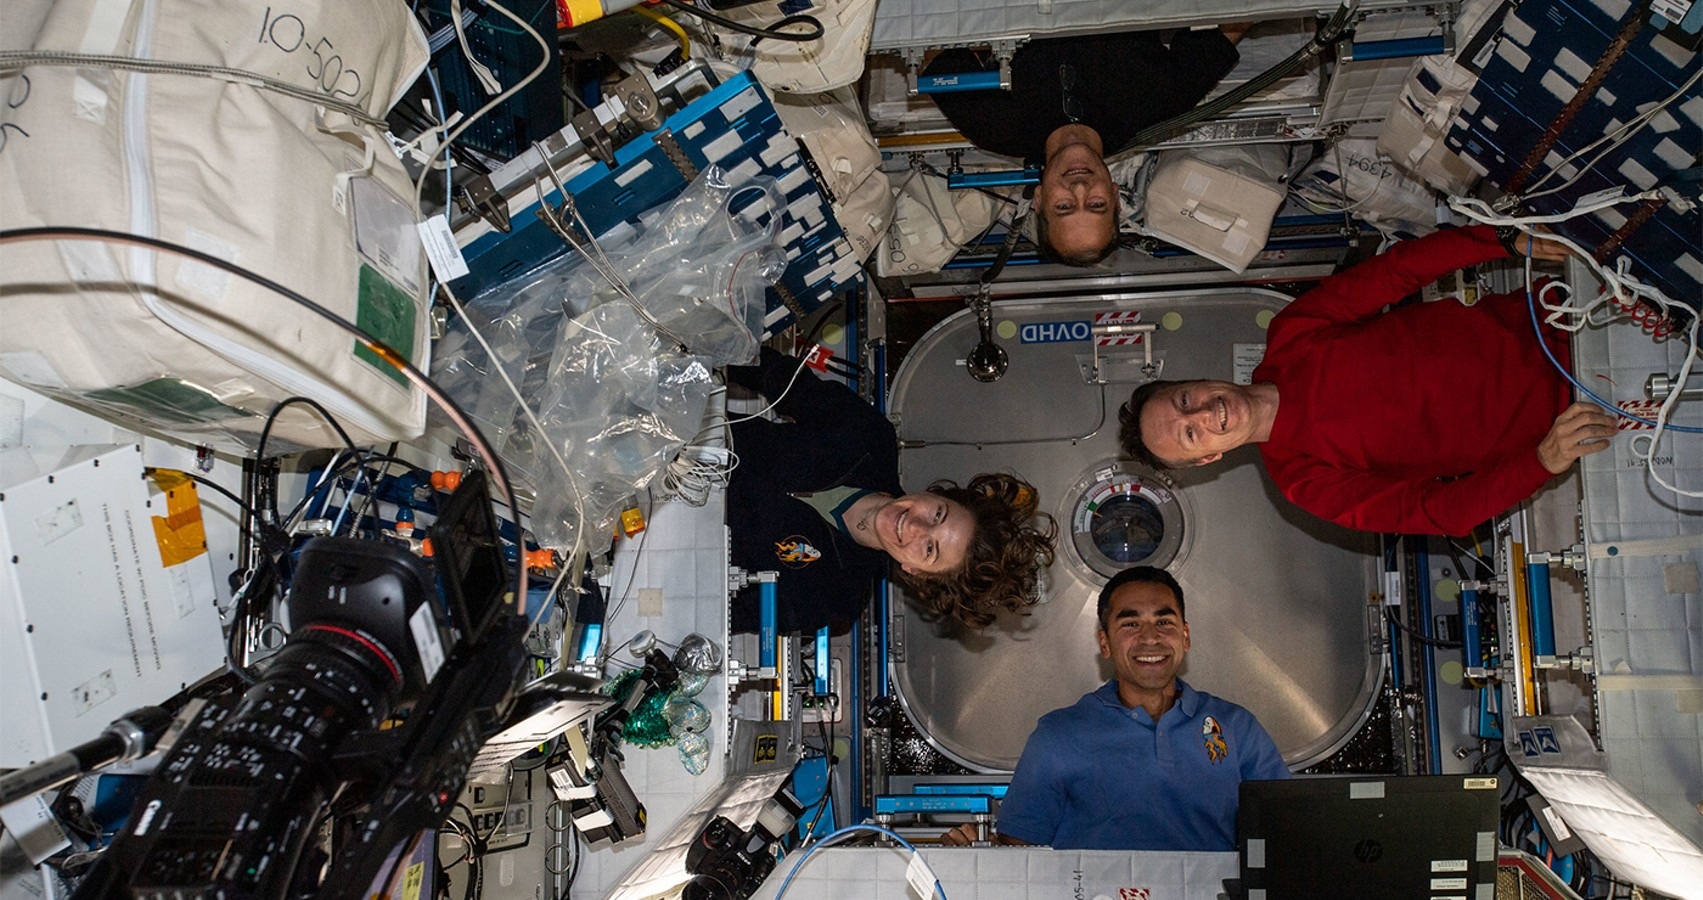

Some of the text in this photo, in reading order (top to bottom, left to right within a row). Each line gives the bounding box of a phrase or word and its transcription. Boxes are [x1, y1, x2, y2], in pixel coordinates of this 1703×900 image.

[1345, 154, 1393, 180] 4394
[1021, 322, 1089, 342] OVHD
[102, 503, 110, 522] THIS
[117, 572, 129, 616] LOCATION
[126, 617, 141, 678] REQUIREMENT
[144, 601, 155, 635] BEFORE
[151, 636, 161, 670] MOVING
[1355, 839, 1382, 864] hp
